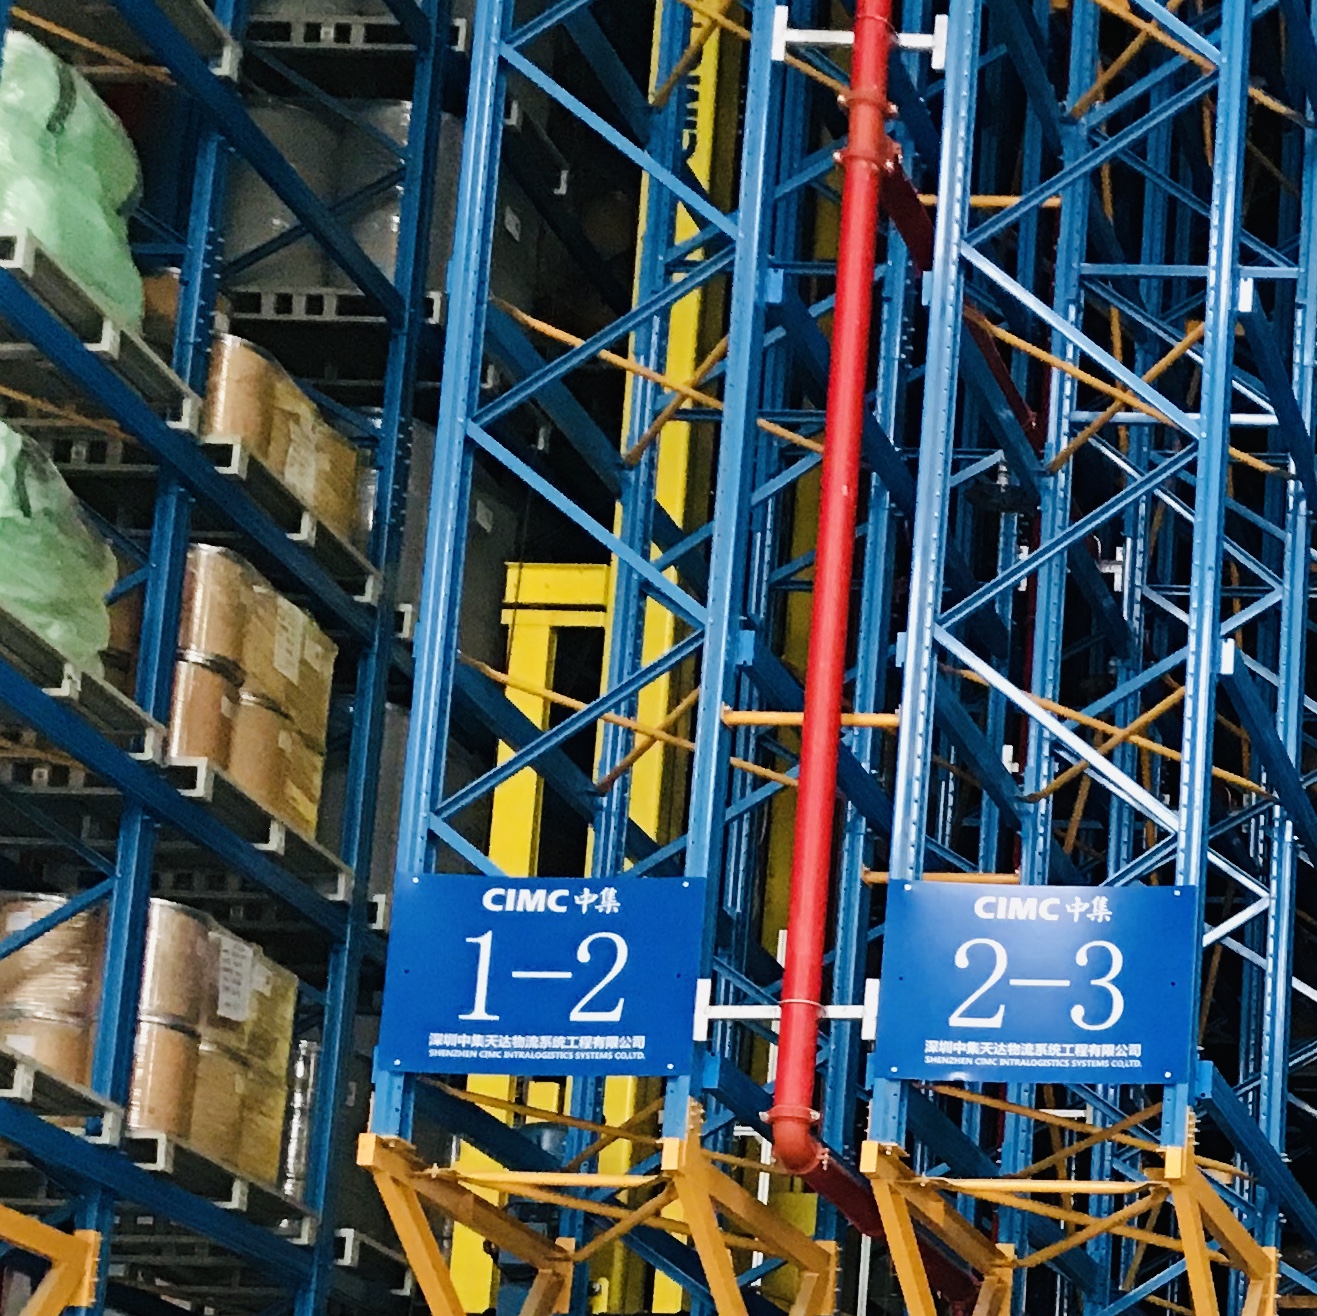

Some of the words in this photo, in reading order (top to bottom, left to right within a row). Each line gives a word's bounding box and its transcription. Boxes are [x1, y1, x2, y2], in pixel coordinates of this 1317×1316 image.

[483, 888, 569, 912] CIMC
[574, 887, 621, 914] 中集
[974, 896, 1060, 920] CIMC
[1065, 896, 1112, 923] 中集
[479, 1050, 502, 1059] CIMC
[575, 1051, 613, 1060] SYSTEMS
[975, 1056, 997, 1066] CIMC
[1071, 1058, 1109, 1067] SYSTEMS
